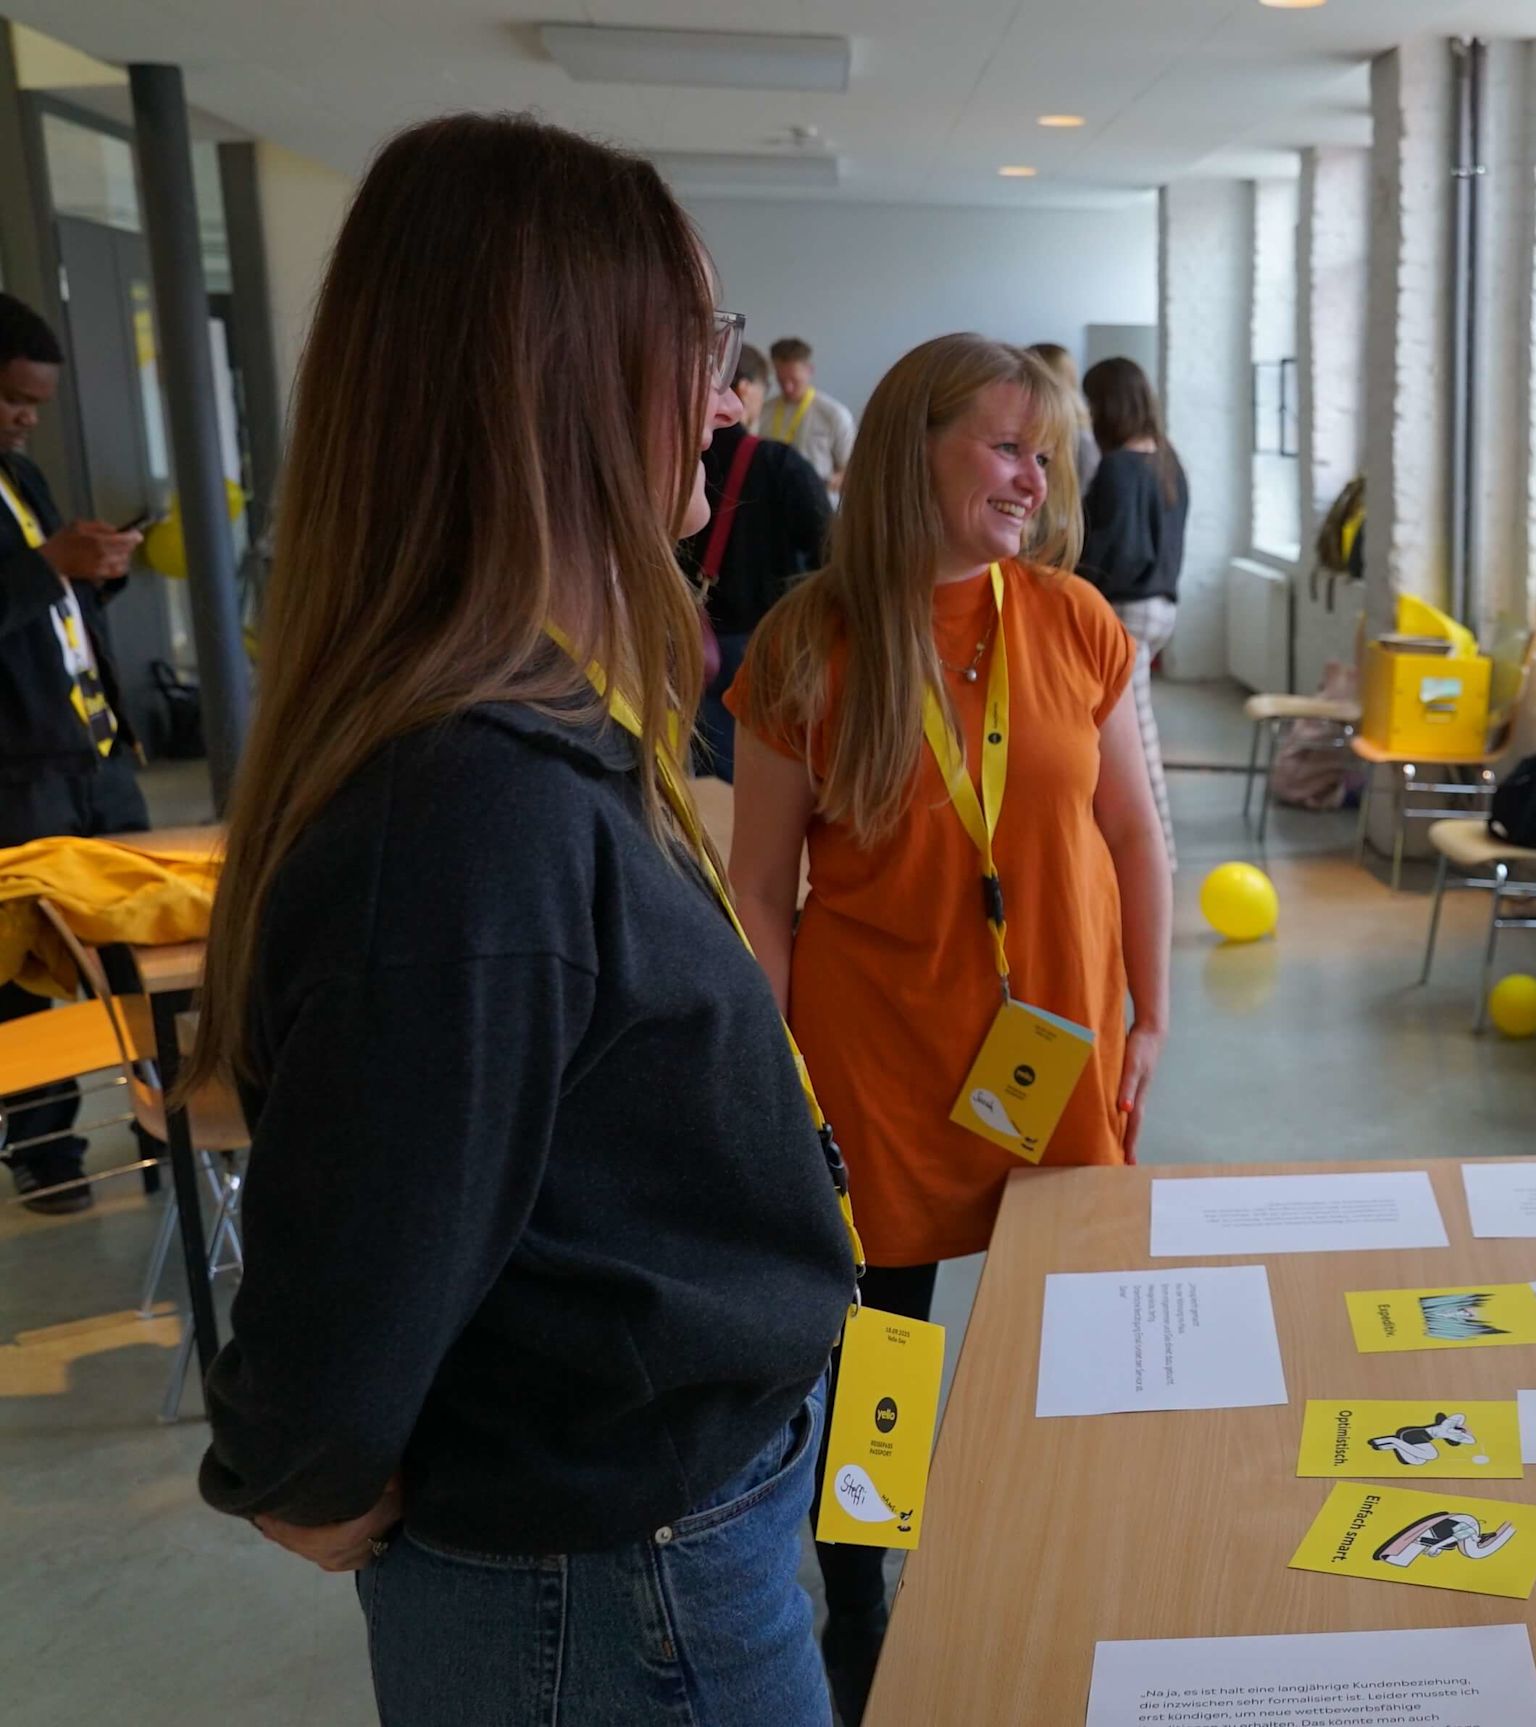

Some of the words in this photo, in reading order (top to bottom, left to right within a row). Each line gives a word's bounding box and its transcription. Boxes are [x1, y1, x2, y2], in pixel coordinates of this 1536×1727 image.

[1376, 1303, 1396, 1339] Expeditiv.
[1333, 1409, 1353, 1467] Optimistisch.
[840, 1473, 867, 1506] Steffi
[1351, 1494, 1381, 1531] Einfach
[1331, 1530, 1360, 1563] smart.
[1139, 1701, 1160, 1710] die
[1162, 1698, 1234, 1710] inzwischen
[1236, 1698, 1265, 1707] sehr
[1267, 1694, 1344, 1706] formalisiert
[1367, 1691, 1409, 1701] Leider
[1410, 1689, 1458, 1699] musste
[1460, 1687, 1480, 1696] ich
[1183, 1688, 1199, 1696] es
[1201, 1687, 1217, 1696] ist
[1219, 1686, 1246, 1695] halt
[1247, 1686, 1275, 1695] eine
[1278, 1682, 1350, 1695] langjährige
[1138, 1713, 1165, 1722] erst
[1167, 1711, 1232, 1723] kündigen,
[1234, 1710, 1257, 1720] um
[1258, 1708, 1292, 1718] neue
[1294, 1703, 1422, 1715] wettbewerbsfähige
[1300, 1718, 1326, 1727] Das
[1328, 1717, 1374, 1727] könnte
[1376, 1715, 1406, 1725] man
[1408, 1713, 1440, 1724] auch
